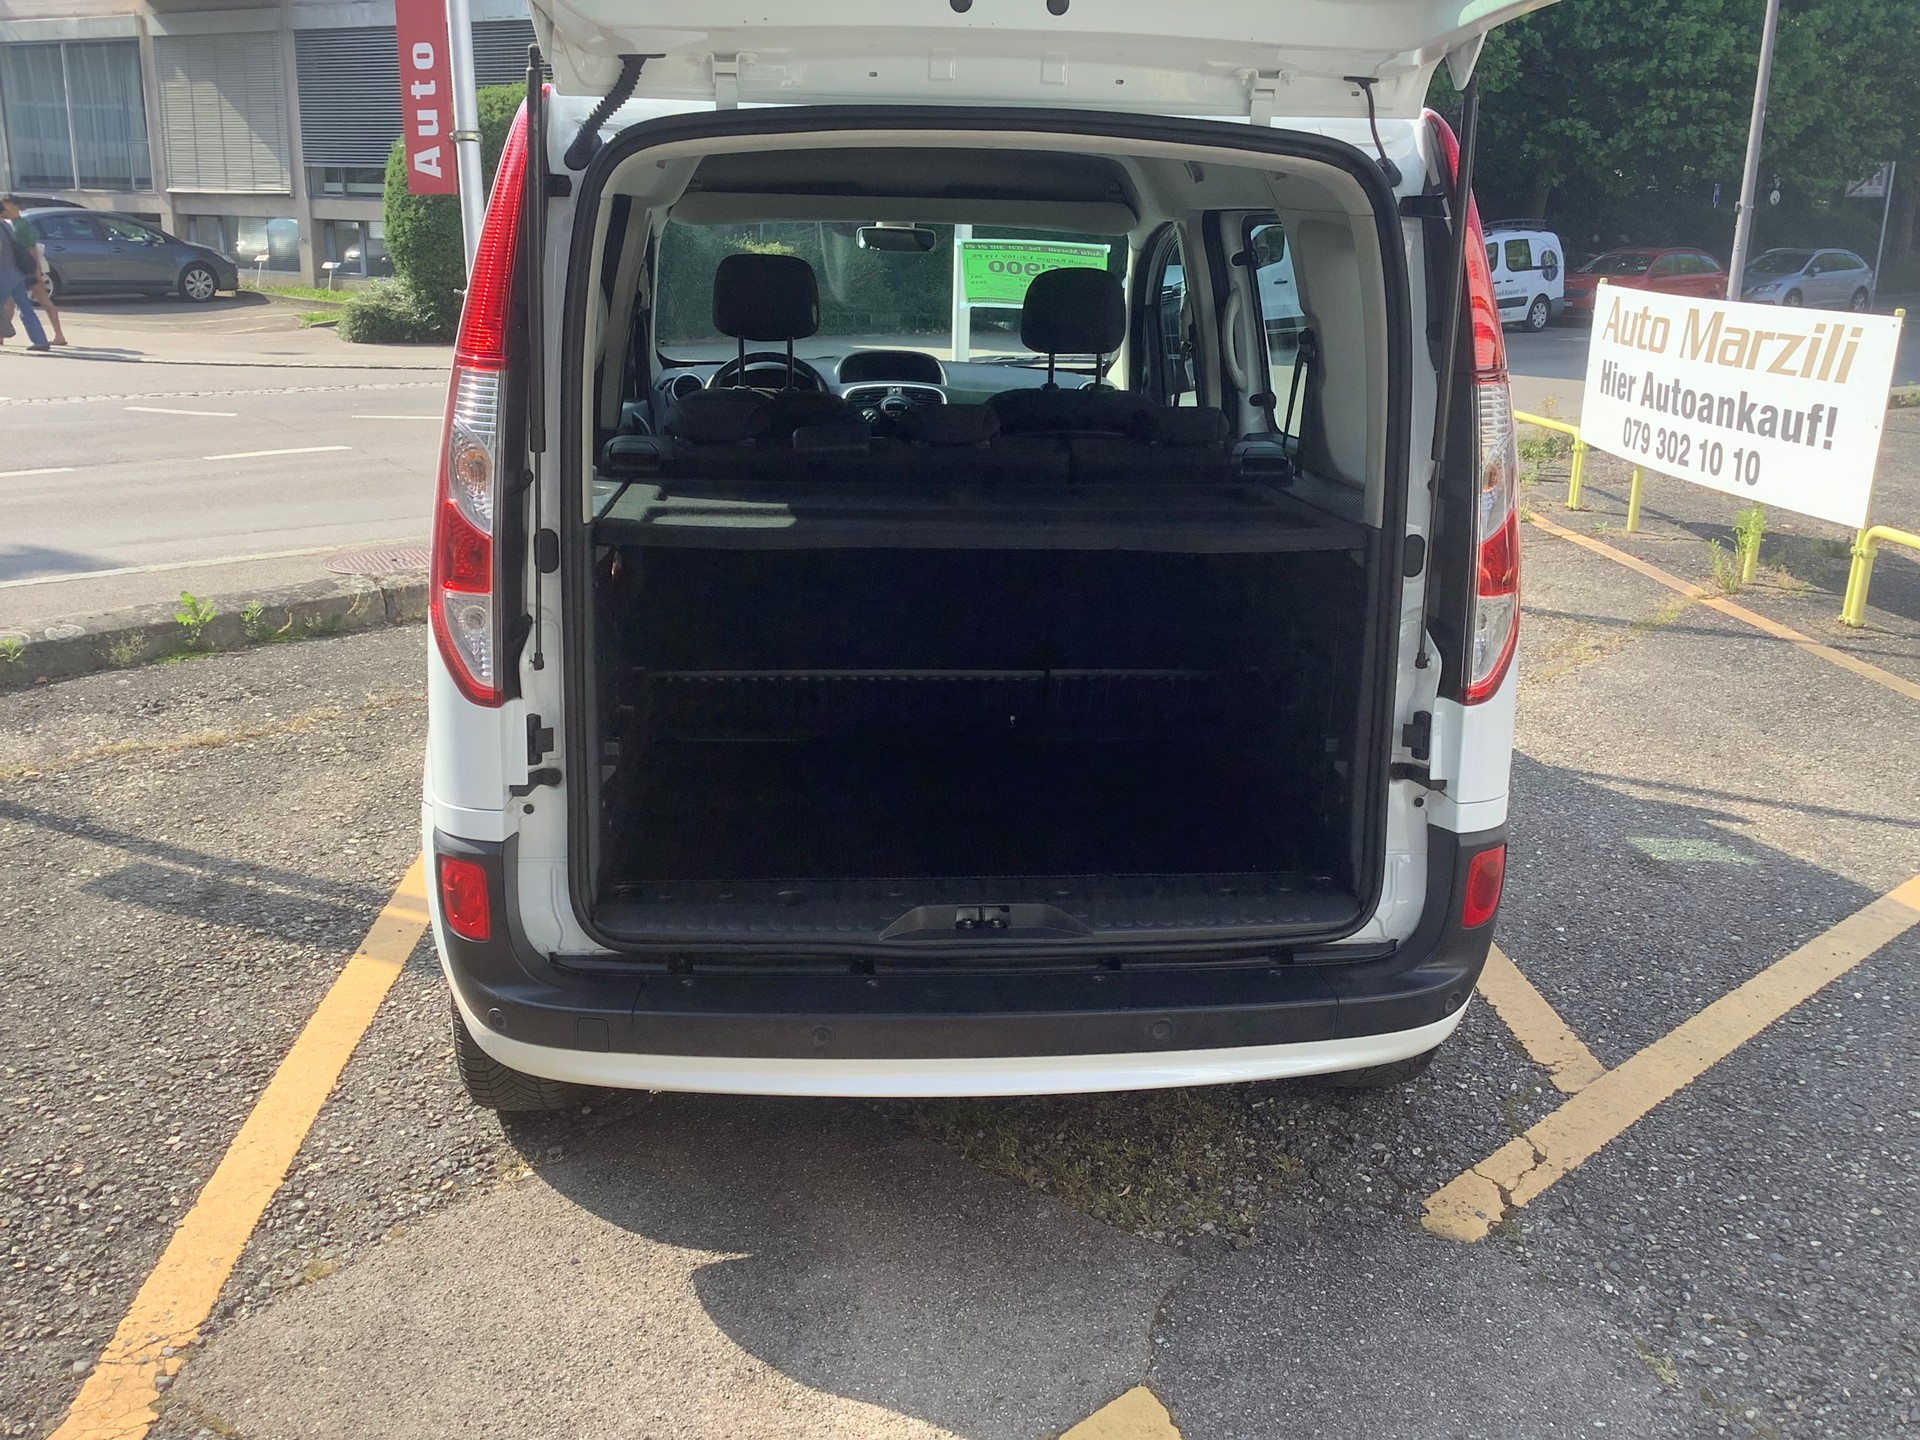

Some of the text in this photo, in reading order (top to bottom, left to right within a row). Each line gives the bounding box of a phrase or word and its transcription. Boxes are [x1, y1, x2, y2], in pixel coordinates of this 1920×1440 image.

[410, 42, 442, 178] Auto
[1602, 296, 1864, 384] Auto Marzili
[1600, 359, 1839, 450] Hier Autoankauf!
[1623, 417, 1761, 487] 079 302 10 10
